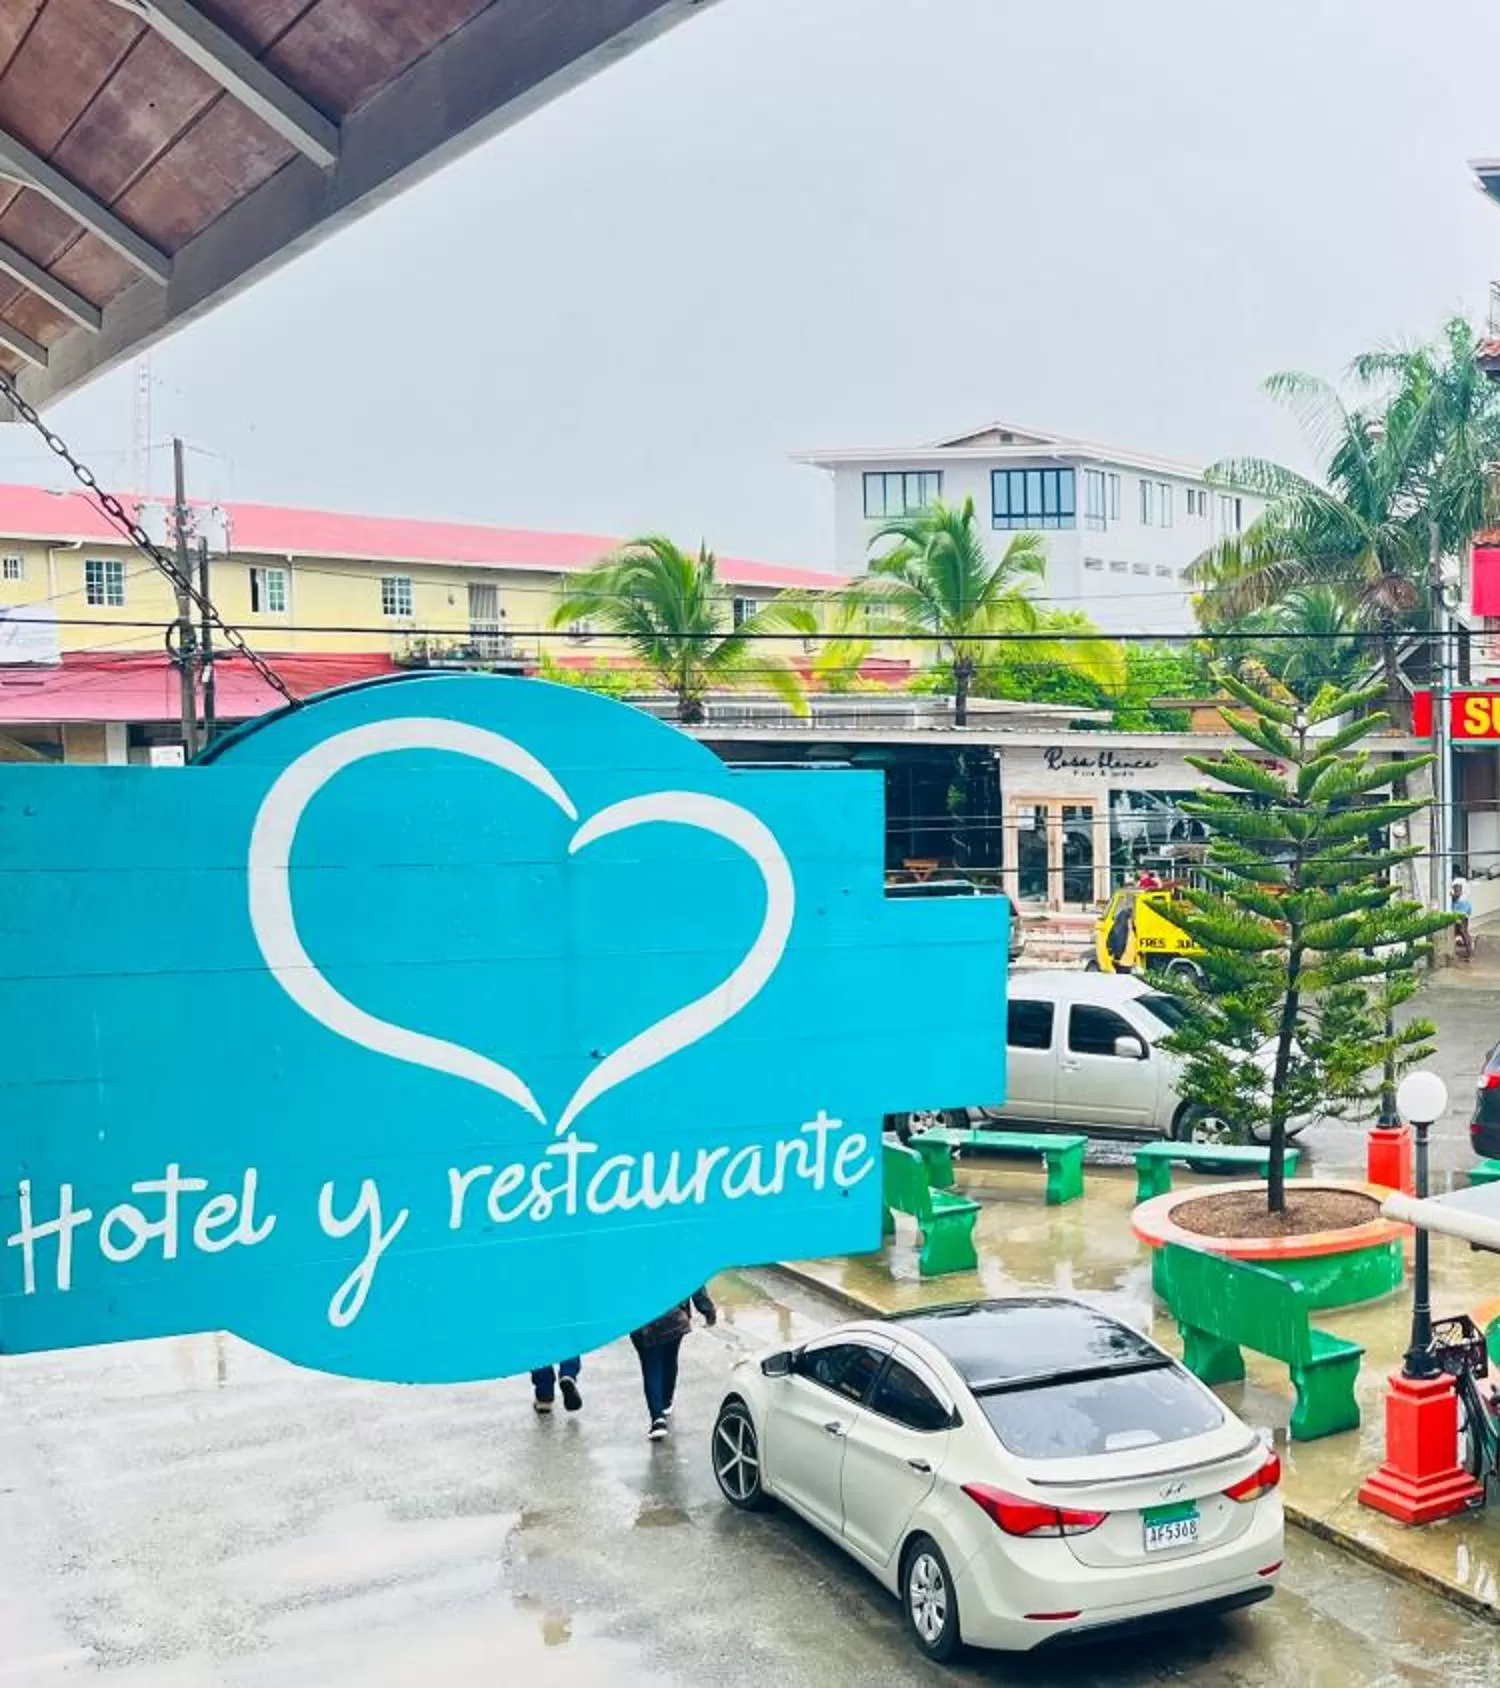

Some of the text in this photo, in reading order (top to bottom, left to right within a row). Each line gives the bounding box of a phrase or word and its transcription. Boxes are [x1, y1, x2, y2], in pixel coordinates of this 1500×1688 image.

[1043, 747, 1096, 771] Rosa
[8, 1110, 874, 1328] Hotel y restaurante
